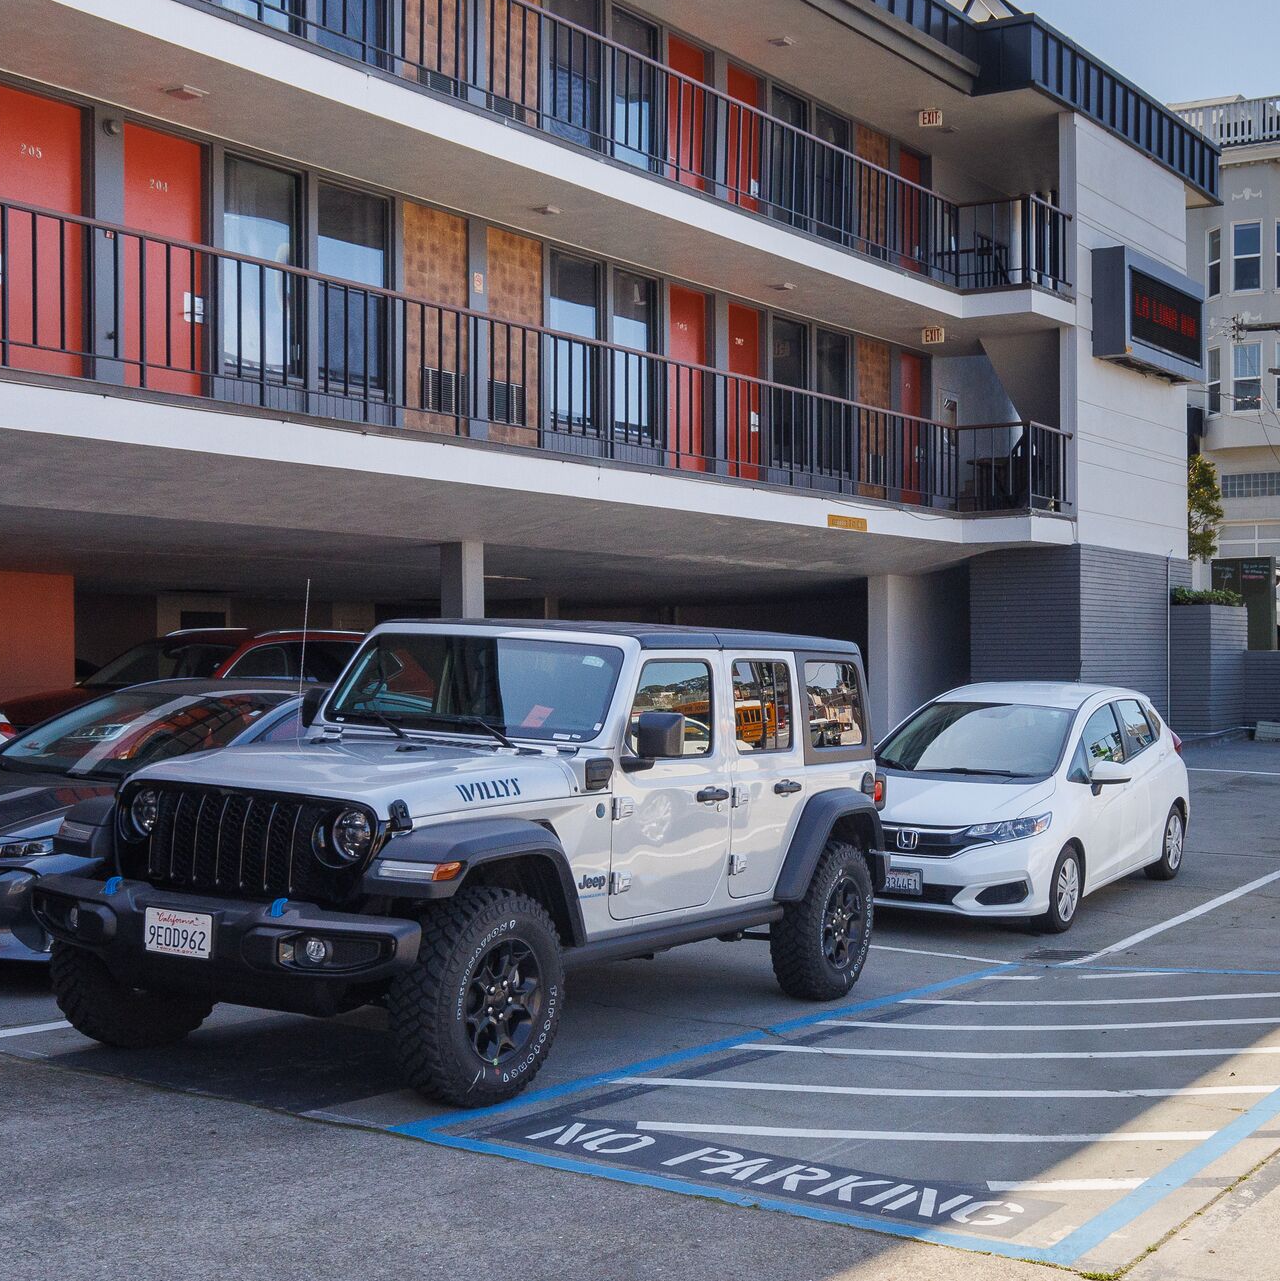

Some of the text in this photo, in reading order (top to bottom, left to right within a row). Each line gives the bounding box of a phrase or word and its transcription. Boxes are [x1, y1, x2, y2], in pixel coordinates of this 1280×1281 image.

[922, 111, 938, 125] EXIT
[21, 143, 42, 159] 205
[925, 329, 940, 343] EXIT
[456, 778, 521, 802] WILLYS
[578, 874, 606, 890] Jeep
[158, 912, 198, 926] California
[525, 1122, 656, 1154] NO
[661, 1146, 1025, 1226] PARKING
